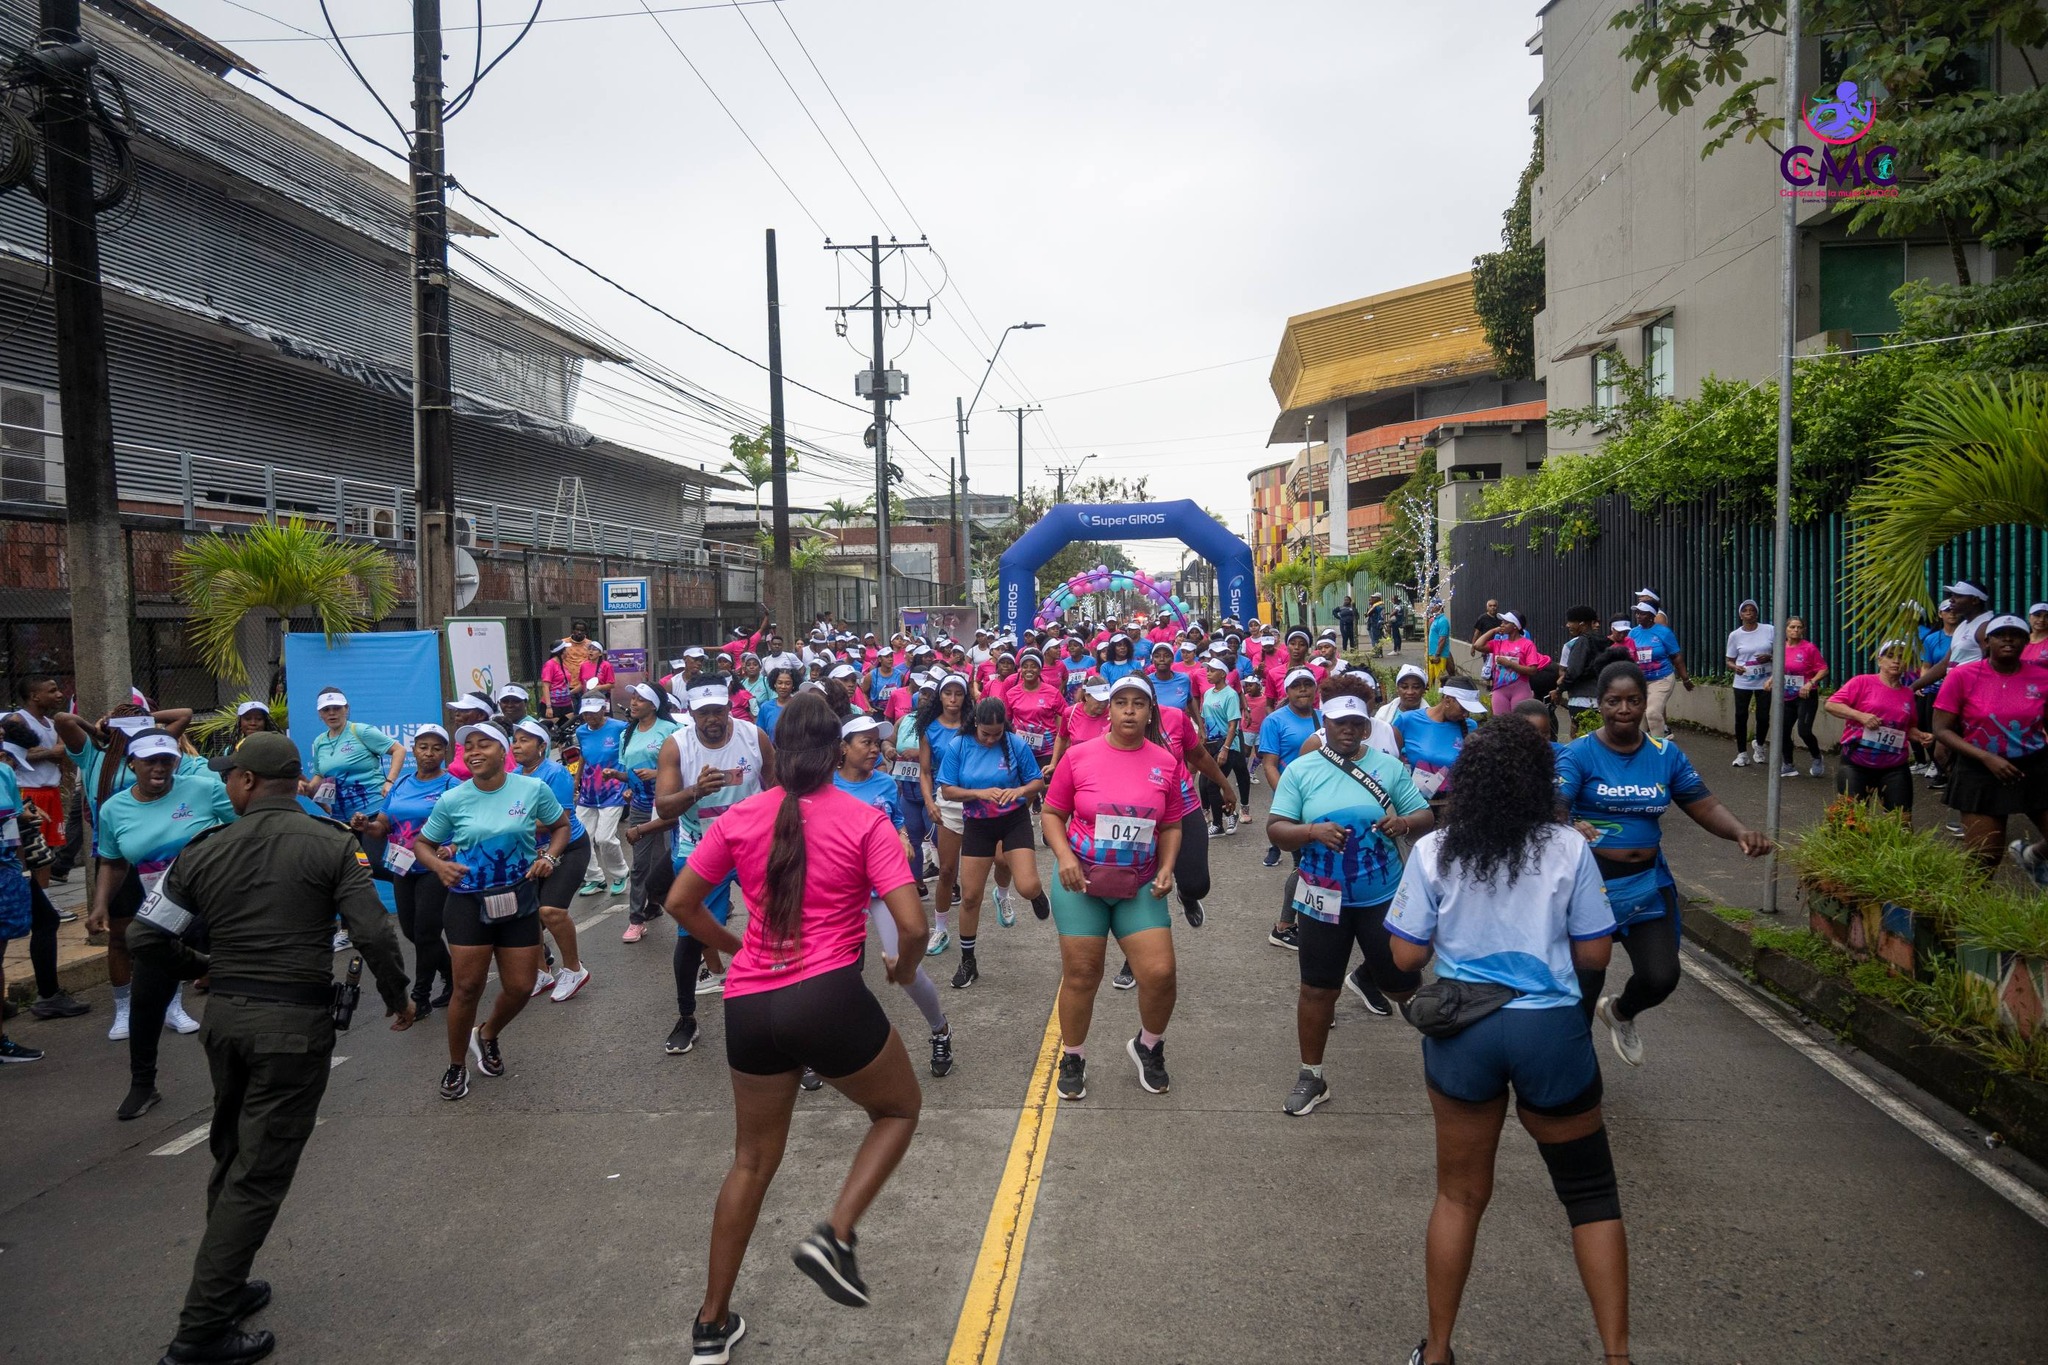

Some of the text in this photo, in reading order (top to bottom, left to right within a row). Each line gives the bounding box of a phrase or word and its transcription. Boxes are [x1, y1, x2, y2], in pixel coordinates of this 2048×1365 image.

[1877, 732, 1896, 746] 149
[1323, 746, 1345, 766] ROMA
[901, 766, 917, 777] 080
[1597, 783, 1657, 799] BetPlay
[171, 811, 193, 819] CMC
[1112, 824, 1141, 842] 047
